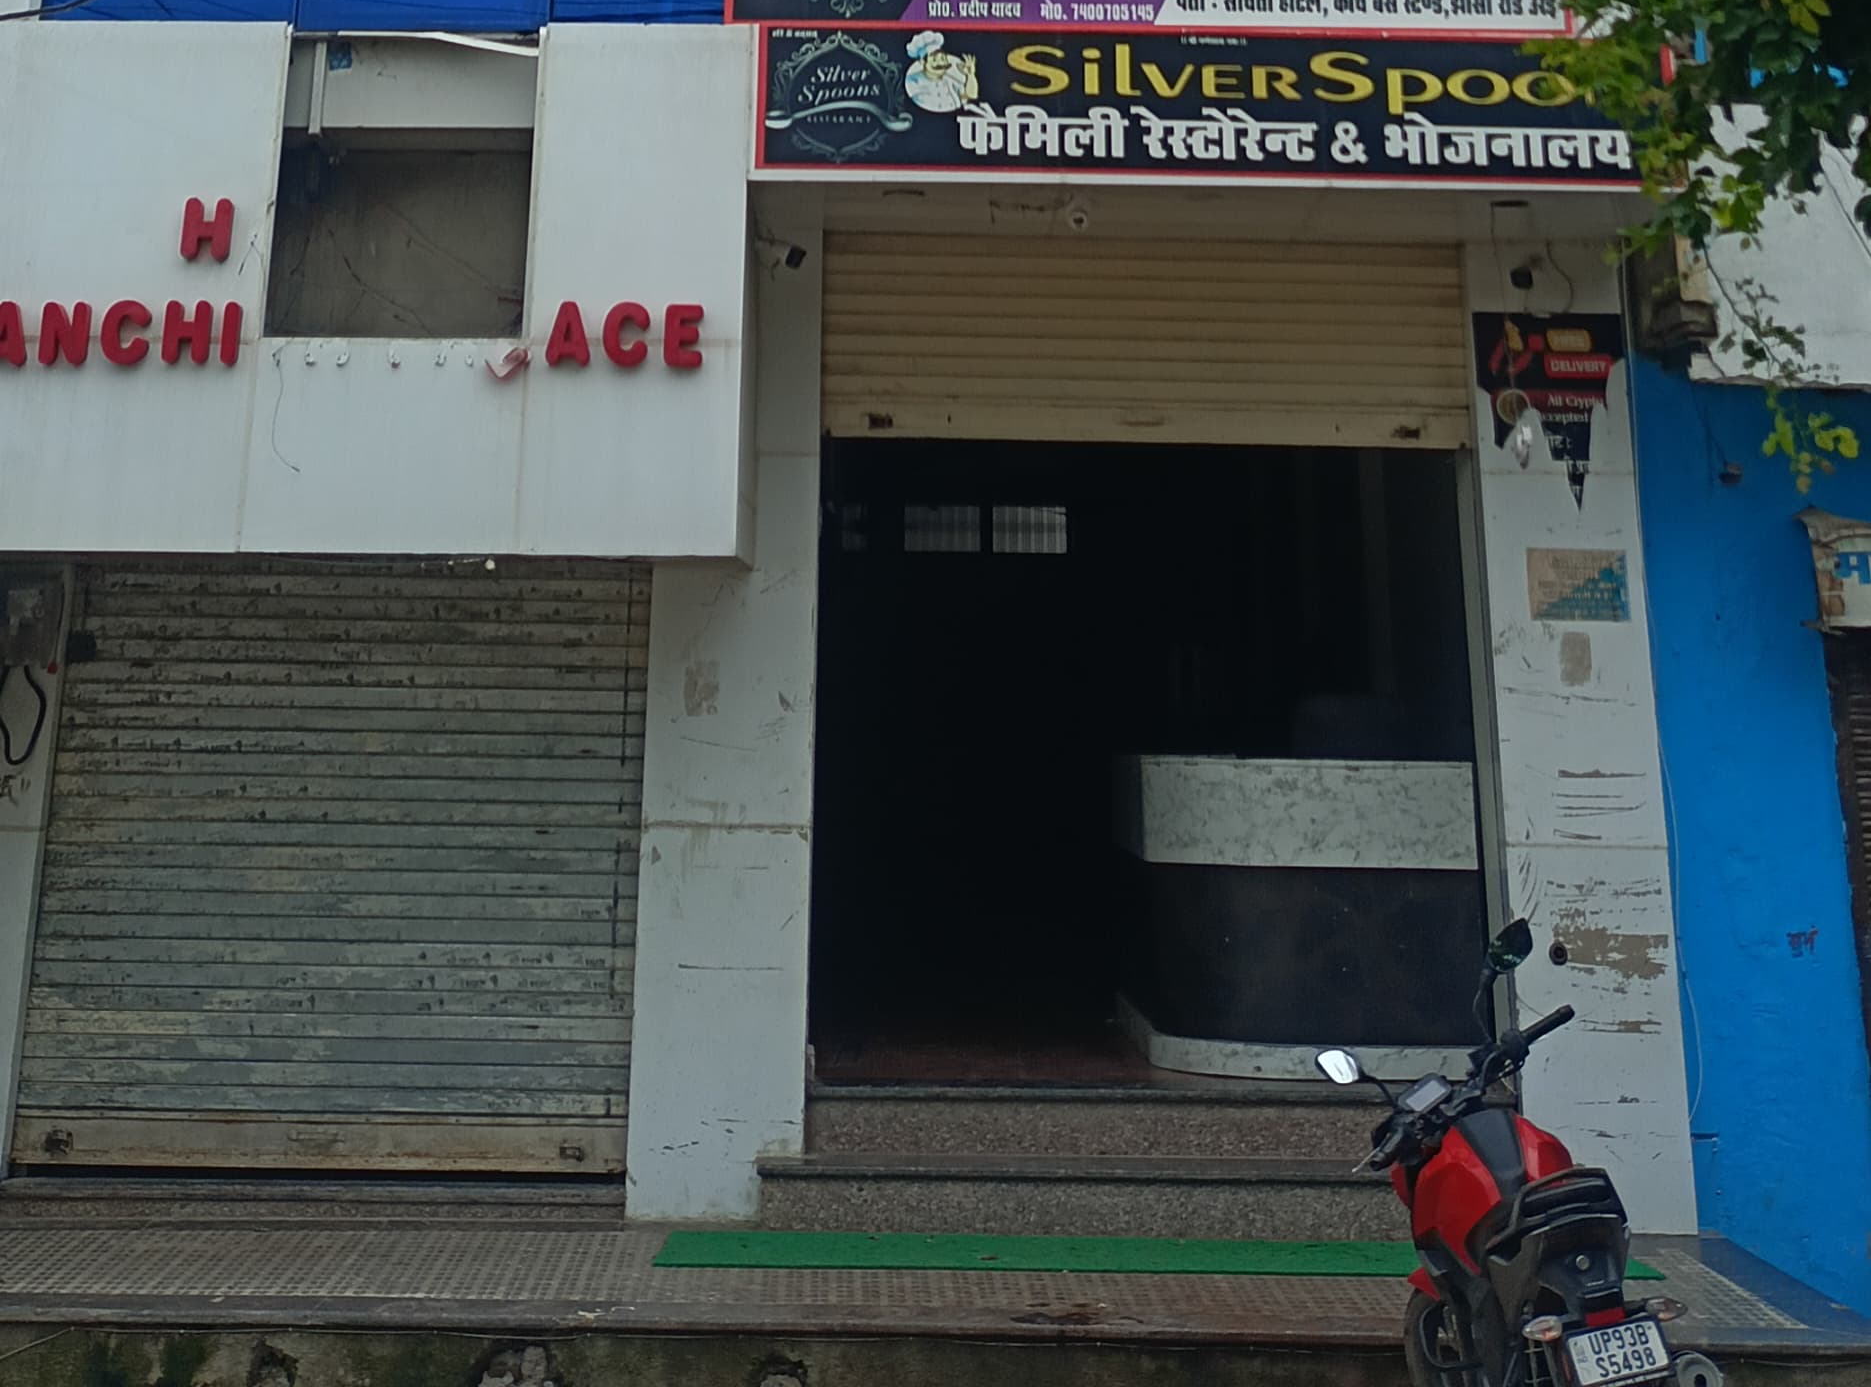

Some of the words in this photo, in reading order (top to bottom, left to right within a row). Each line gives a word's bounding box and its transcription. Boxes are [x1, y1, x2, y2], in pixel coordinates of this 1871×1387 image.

[811, 64, 871, 83] Silver
[798, 84, 880, 106] Spoons
[956, 102, 1129, 159] फैमिली
[1330, 120, 1369, 165] &
[1384, 112, 1633, 170] भोजनालय
[180, 197, 235, 263] H
[545, 301, 706, 369] ACE
[1550, 360, 1607, 373] DELIVERY
[1588, 1324, 1649, 1355] UP93B
[1595, 1347, 1657, 1378] S5498
